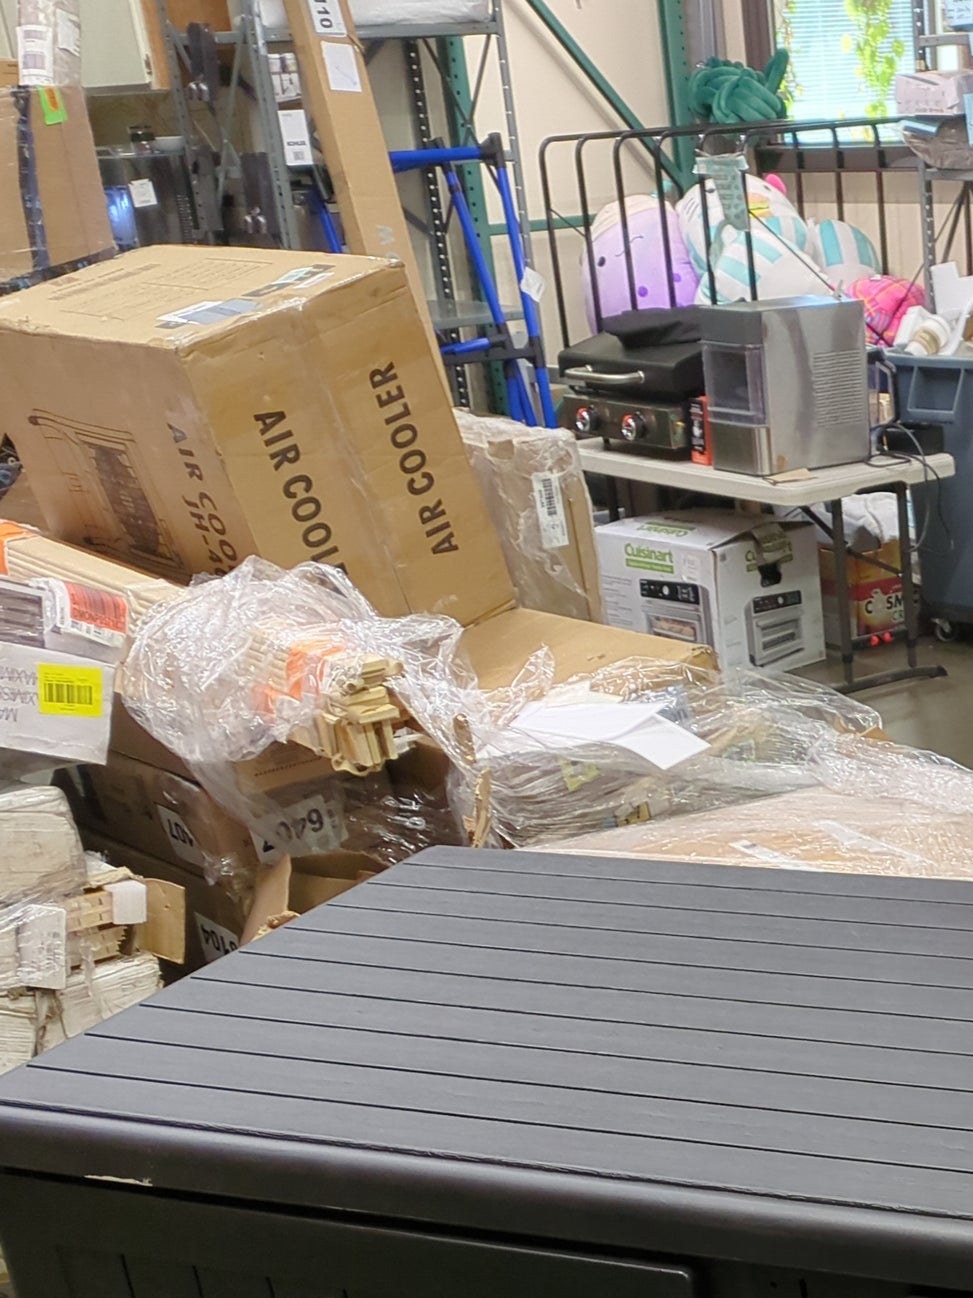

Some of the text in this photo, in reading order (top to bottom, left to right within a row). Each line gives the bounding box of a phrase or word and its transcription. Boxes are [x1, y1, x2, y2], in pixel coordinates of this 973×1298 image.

[167, 423, 238, 571] AIR COO
[253, 410, 348, 575] AIR COOL
[369, 361, 459, 555] AIR COOLER
[624, 543, 674, 564] Cuisinart
